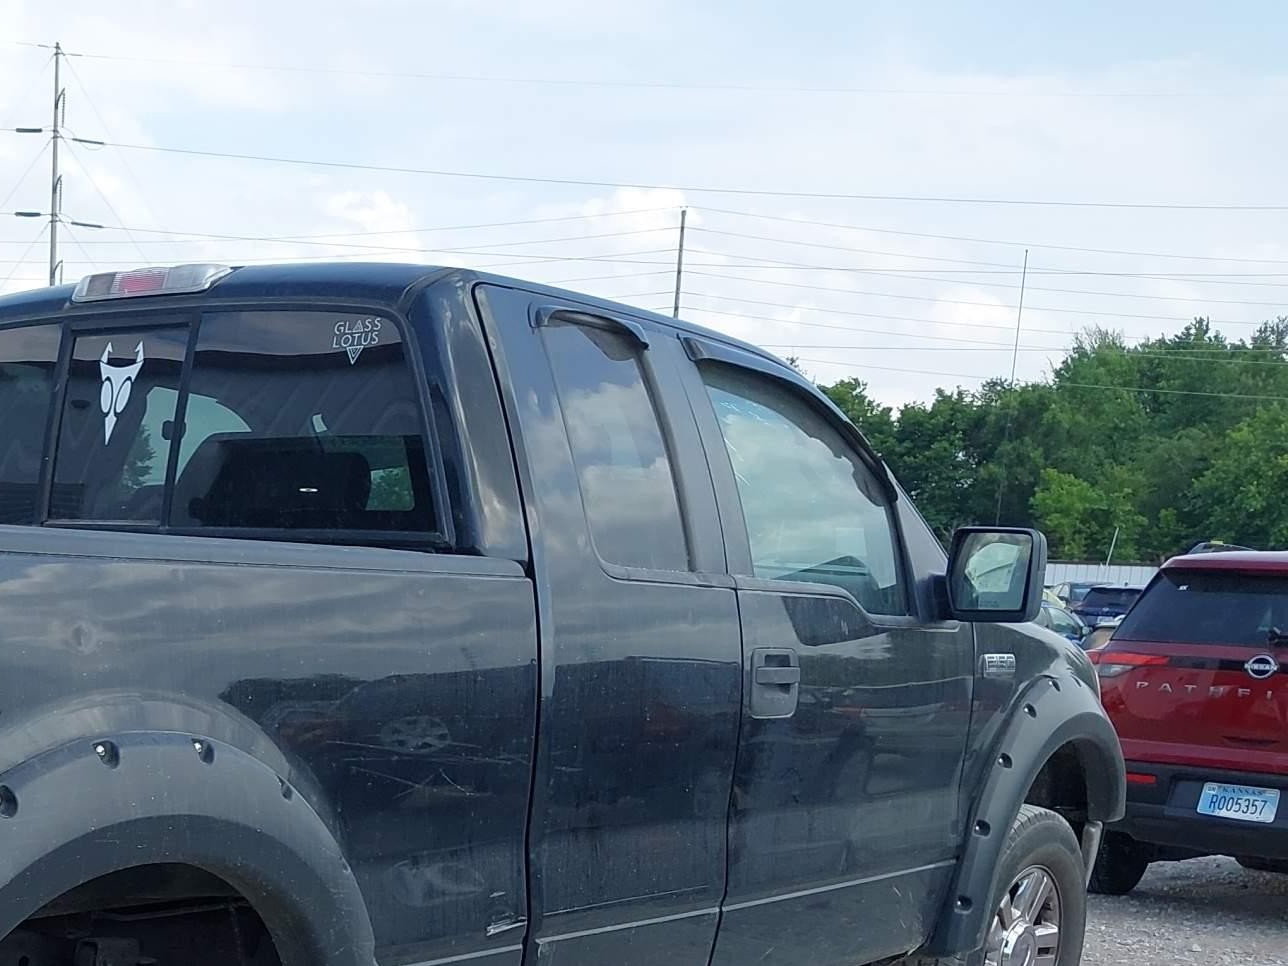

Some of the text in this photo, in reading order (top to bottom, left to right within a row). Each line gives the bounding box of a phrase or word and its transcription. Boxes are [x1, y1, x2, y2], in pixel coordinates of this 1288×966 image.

[334, 317, 382, 335] GLASS
[332, 331, 379, 348] LOTUS
[1208, 794, 1268, 817] R005357
